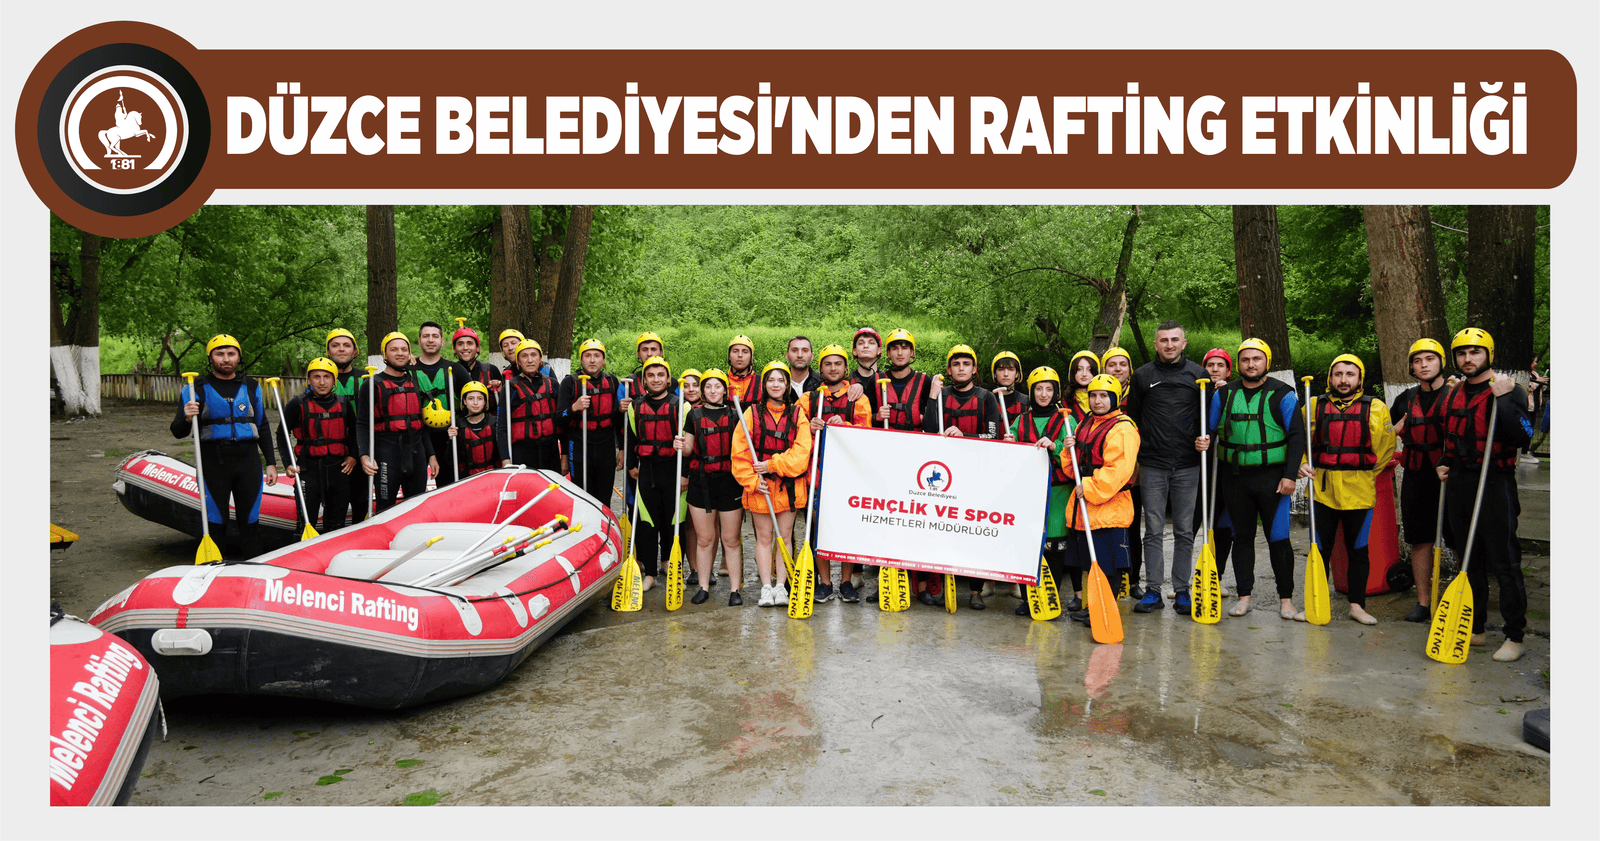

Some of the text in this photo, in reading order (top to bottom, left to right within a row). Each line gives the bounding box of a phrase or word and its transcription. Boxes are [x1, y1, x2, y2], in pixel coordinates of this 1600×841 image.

[141, 463, 183, 485] Melenci
[847, 495, 1016, 526] GENÇLİK VE SPOR
[861, 513, 999, 538] HİZMETLERİ MÜDÜRLÜĞÜ
[264, 578, 419, 631] Melenci Rafting
[72, 642, 143, 711] Rafting
